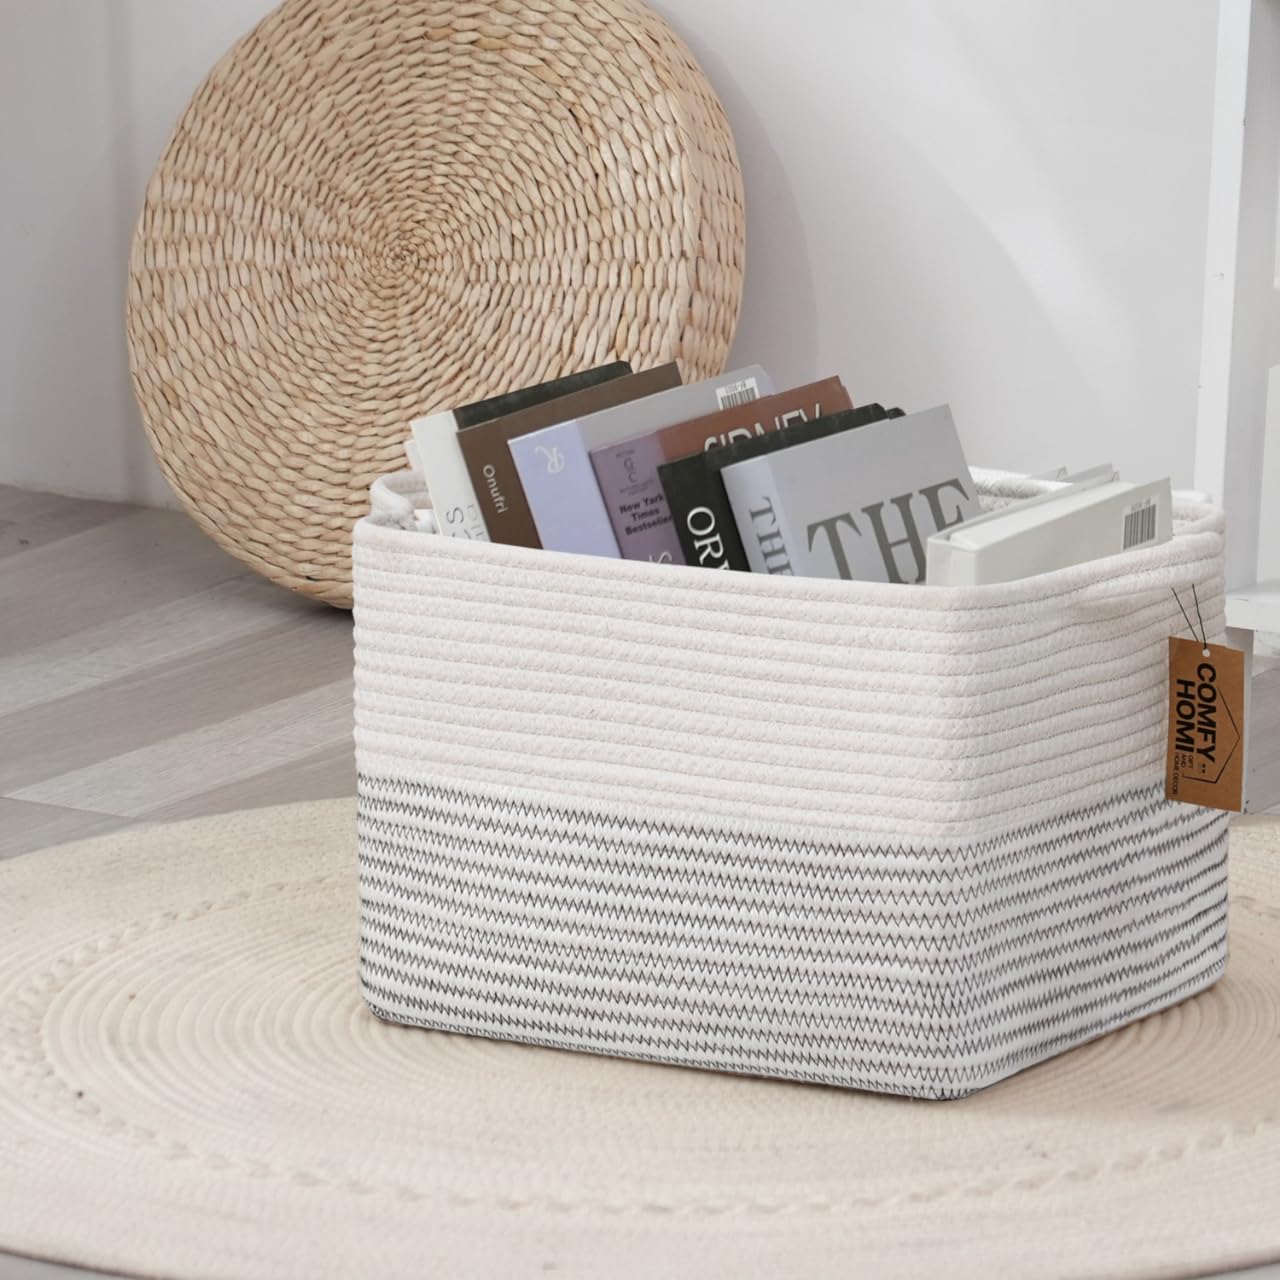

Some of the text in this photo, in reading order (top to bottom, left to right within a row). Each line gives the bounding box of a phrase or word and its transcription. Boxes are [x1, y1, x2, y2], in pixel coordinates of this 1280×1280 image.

[619, 502, 641, 514] New
[631, 508, 660, 522] Times
[687, 506, 730, 570] OR
[807, 478, 970, 584] THE
[1175, 679, 1195, 753] HOMI
[1197, 663, 1217, 763] COMFY
